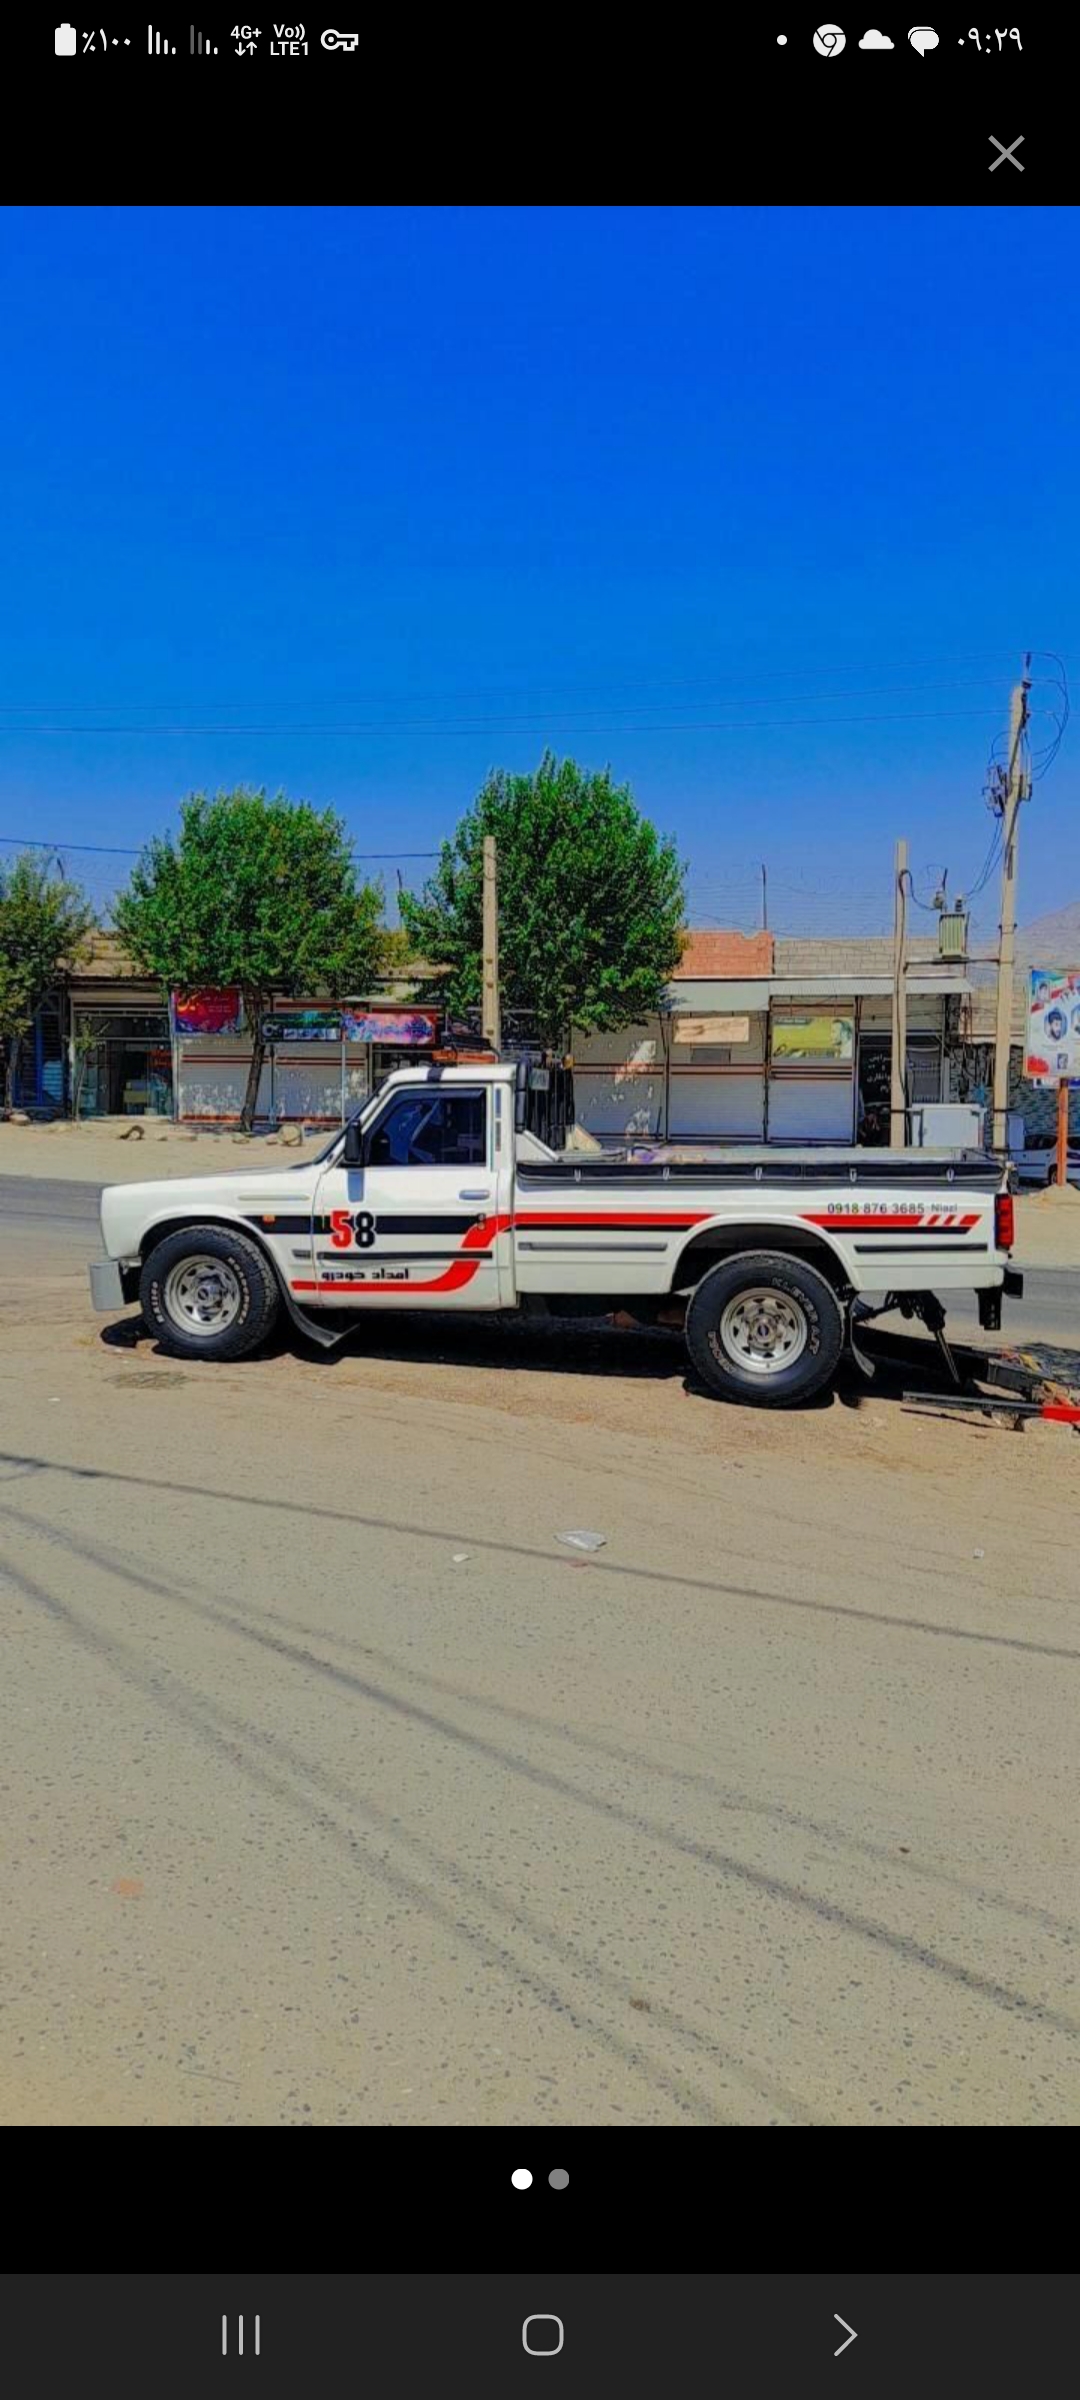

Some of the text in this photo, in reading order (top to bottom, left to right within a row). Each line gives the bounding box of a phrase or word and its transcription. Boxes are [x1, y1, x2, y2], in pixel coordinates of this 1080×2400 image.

[827, 1202, 859, 1214] 0918
[863, 1202, 887, 1214] 876
[891, 1202, 925, 1214] 3685
[329, 1209, 377, 1248] 58
[371, 1267, 409, 1280] امداد
